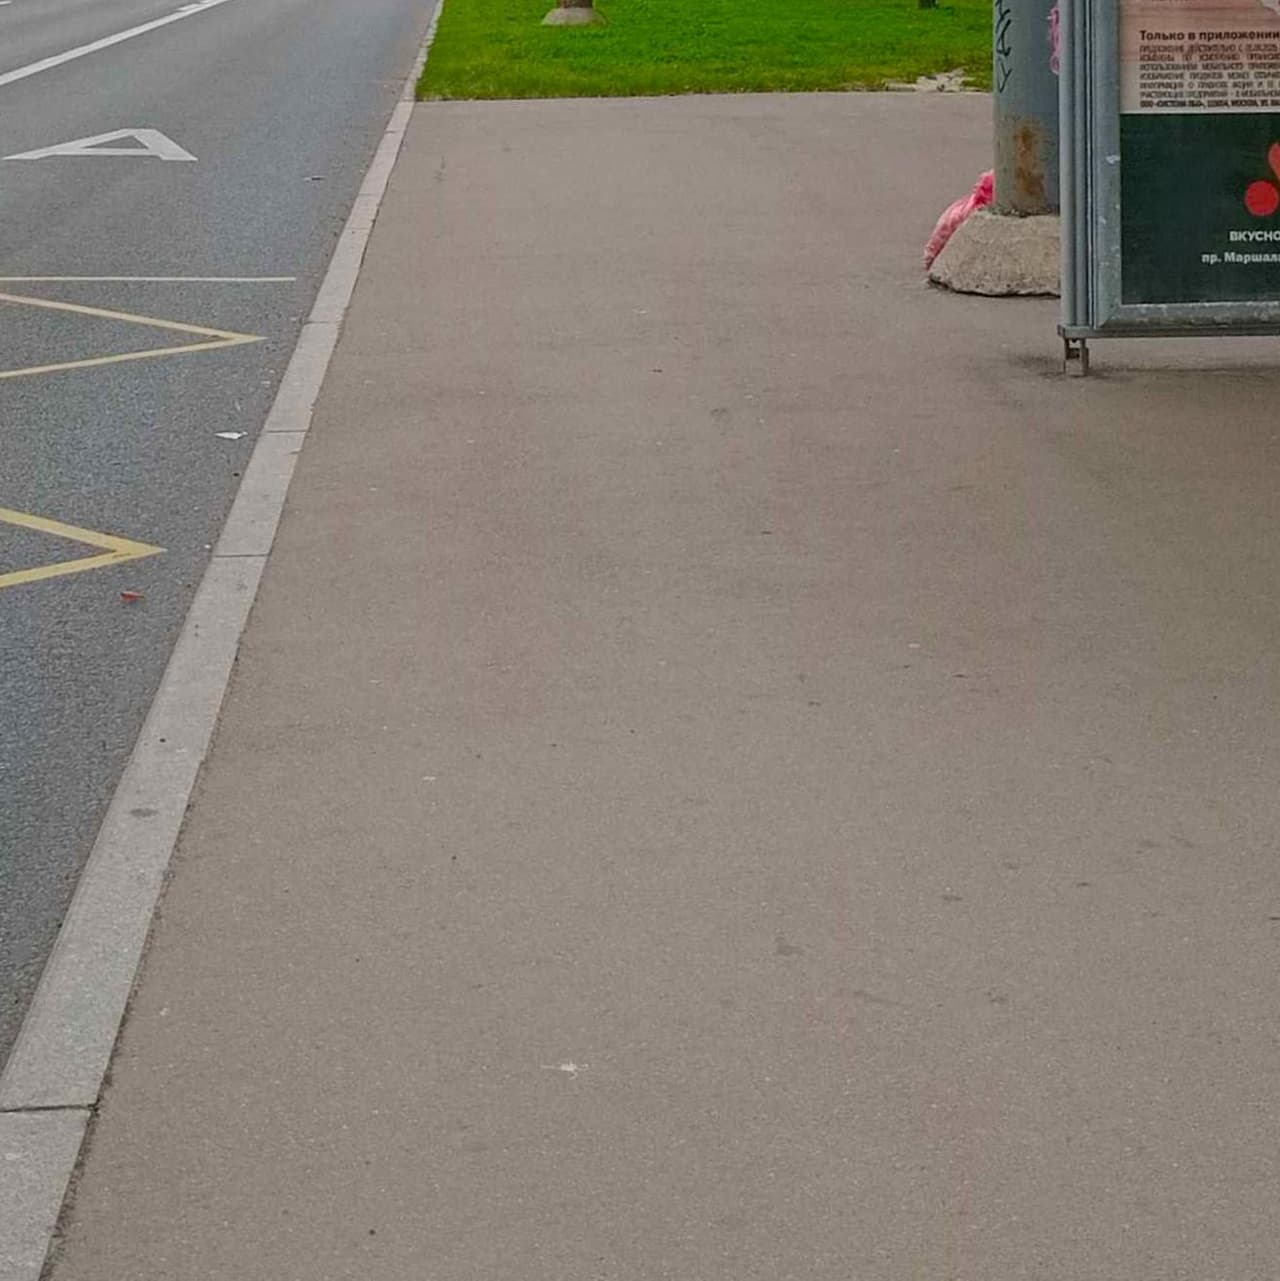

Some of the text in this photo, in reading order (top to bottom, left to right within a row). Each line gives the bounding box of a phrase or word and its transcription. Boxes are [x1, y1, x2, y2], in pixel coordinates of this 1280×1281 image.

[1139, 30, 1280, 42] Только в приложении
[1201, 253, 1222, 266] пр.
